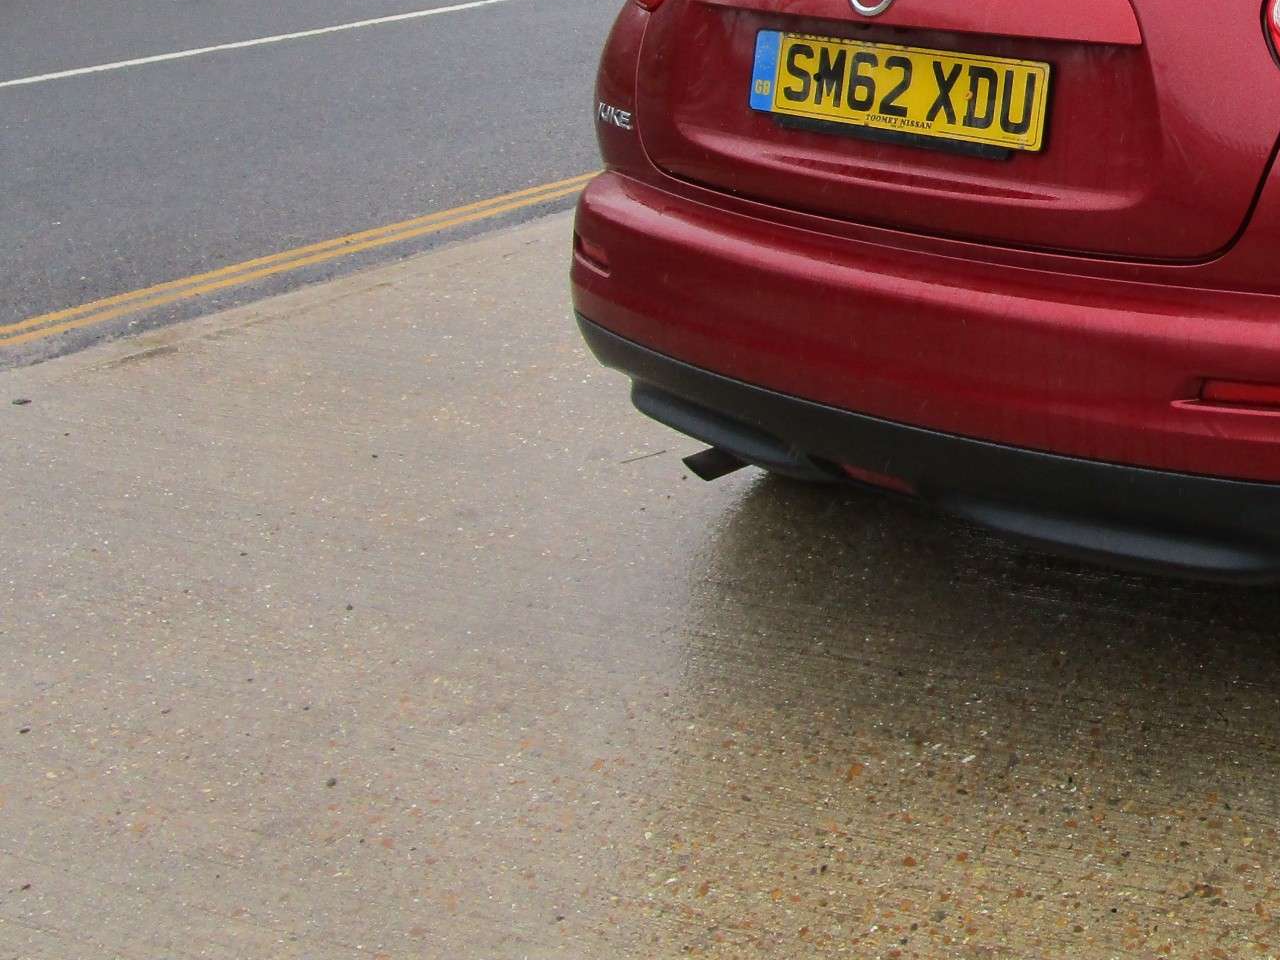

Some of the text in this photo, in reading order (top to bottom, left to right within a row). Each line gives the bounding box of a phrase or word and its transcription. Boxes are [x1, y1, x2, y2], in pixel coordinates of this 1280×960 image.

[783, 43, 1036, 135] SM62 XDU
[866, 113, 899, 125] TOOMEY
[900, 118, 933, 129] NISSAN
